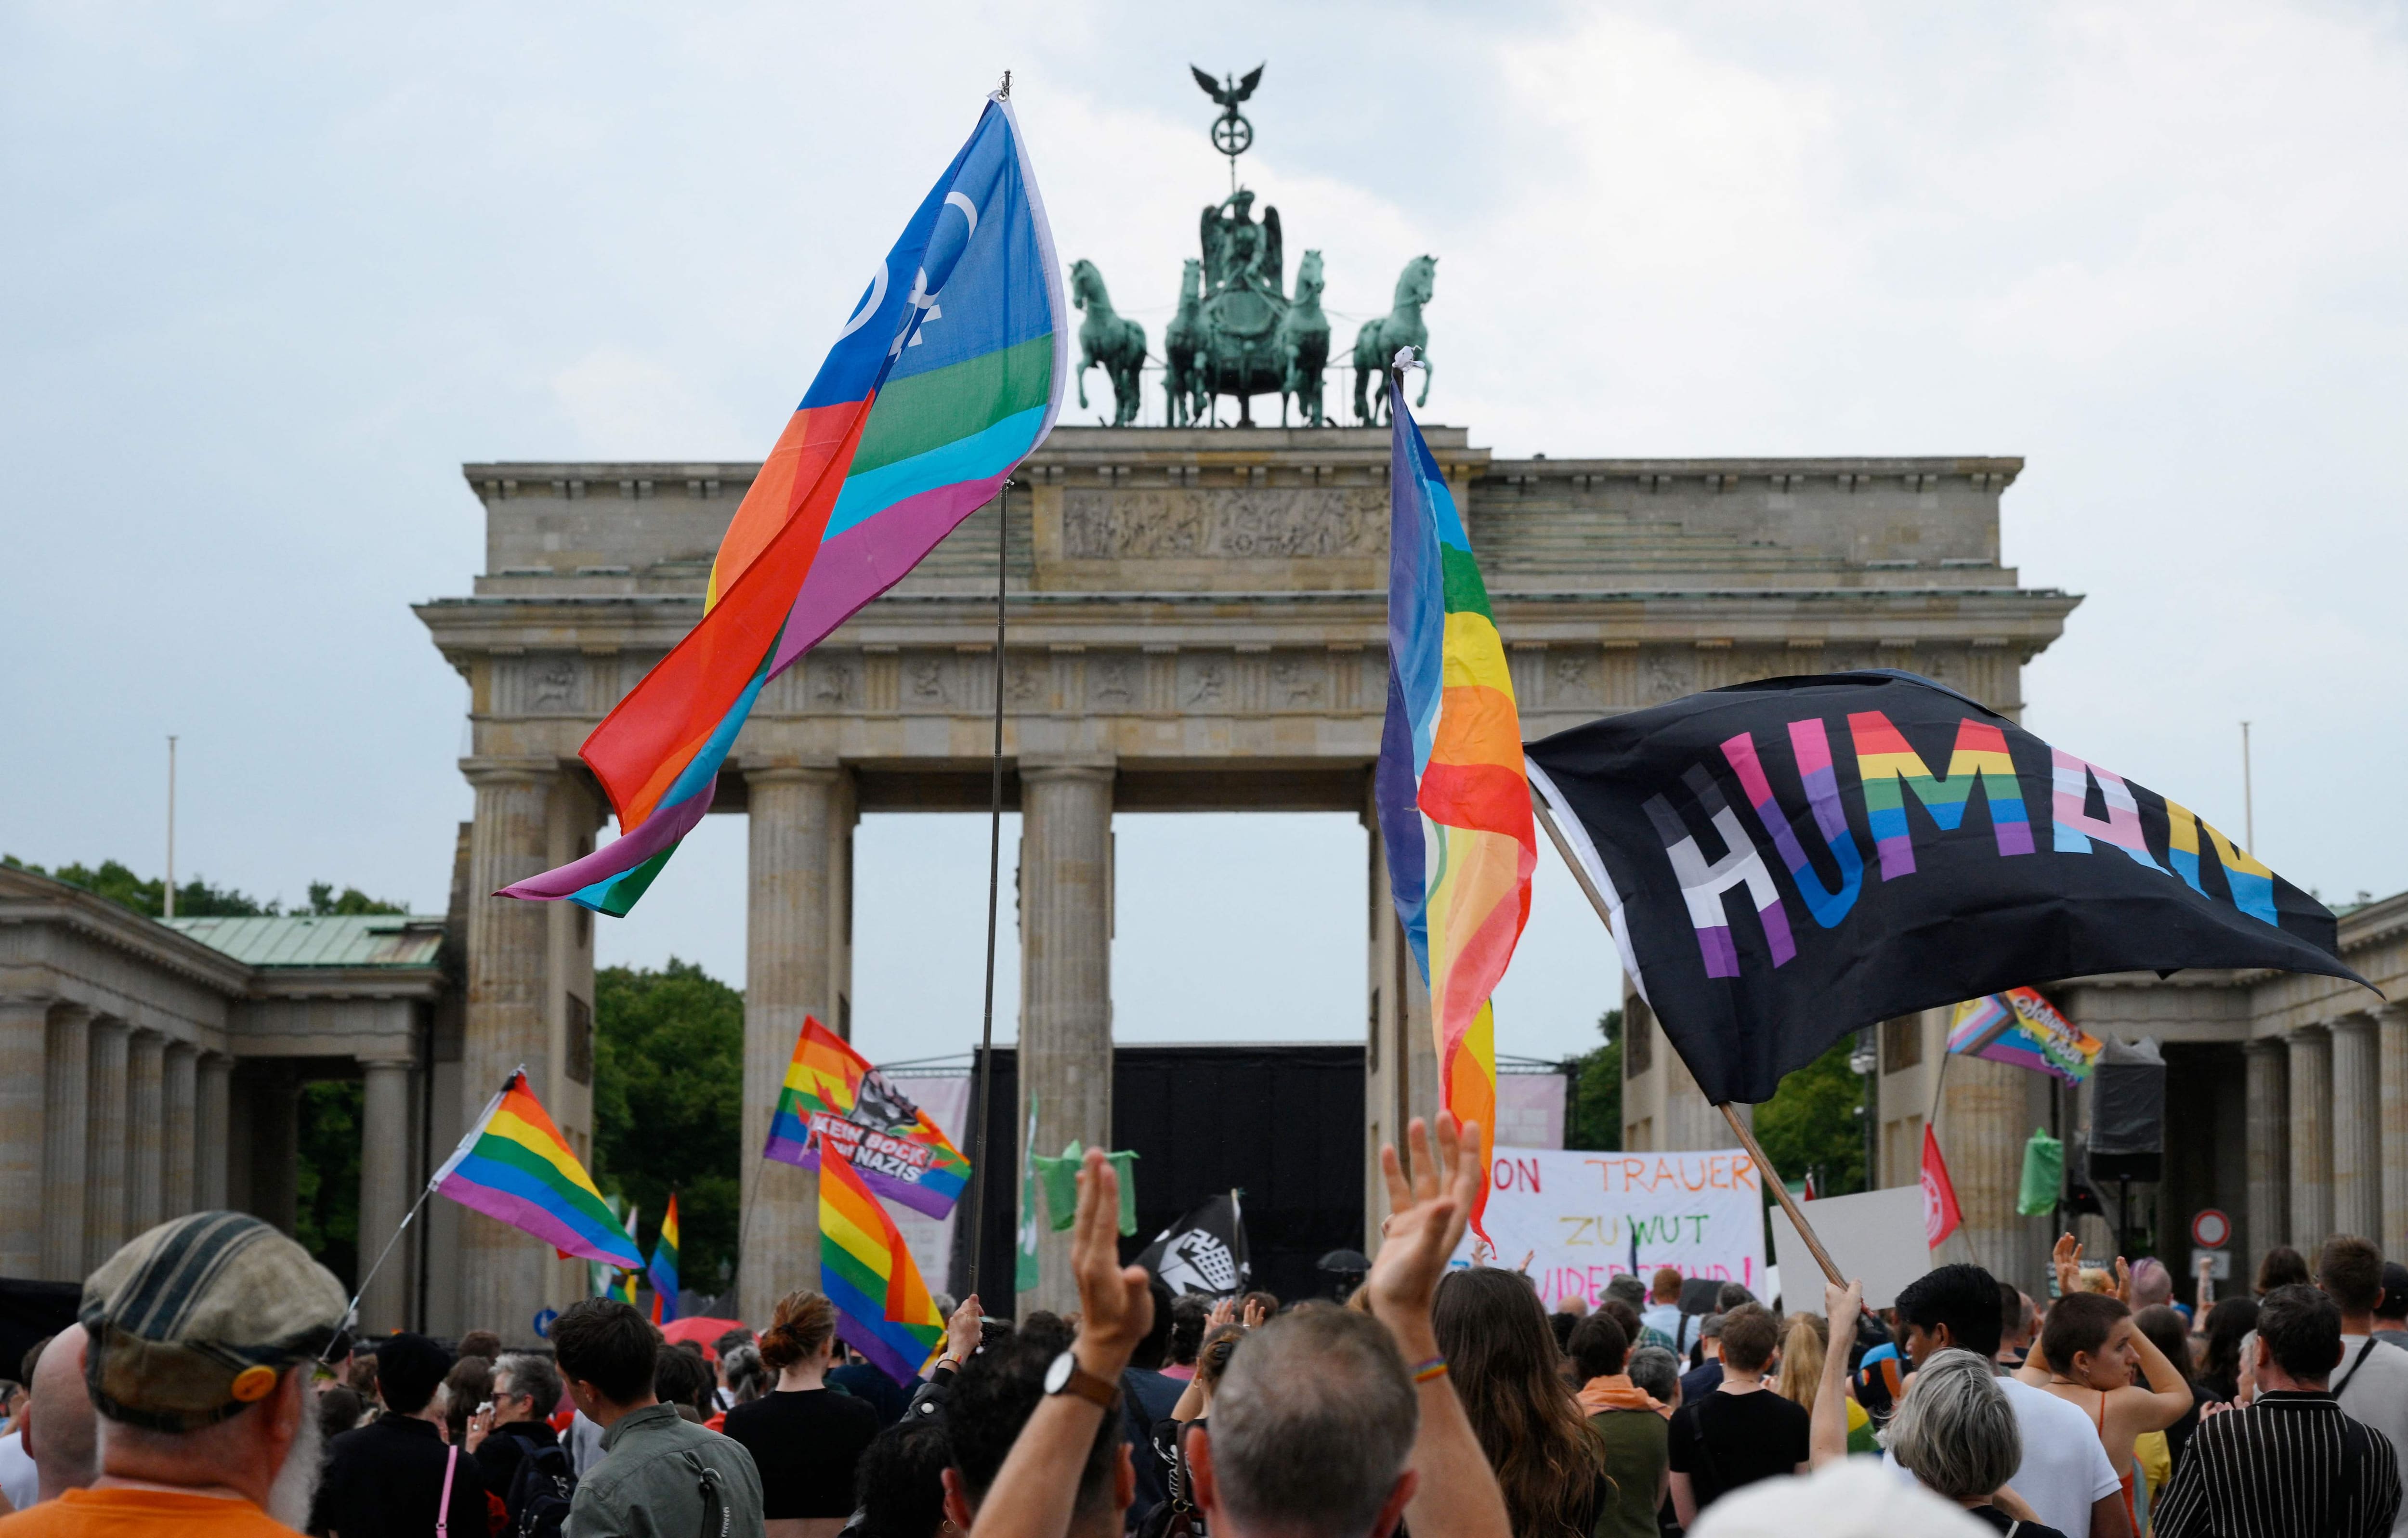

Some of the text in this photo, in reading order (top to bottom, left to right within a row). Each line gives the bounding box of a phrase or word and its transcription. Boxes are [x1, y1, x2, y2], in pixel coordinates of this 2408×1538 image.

[1641, 710, 2278, 979] HUMAN
[812, 1116, 928, 1167] KEIN BOCK
[854, 1146, 922, 1183] NAZIS
[1494, 1156, 1756, 1193] ON TRAUER
[1559, 1214, 1709, 1246] ZU WUT
